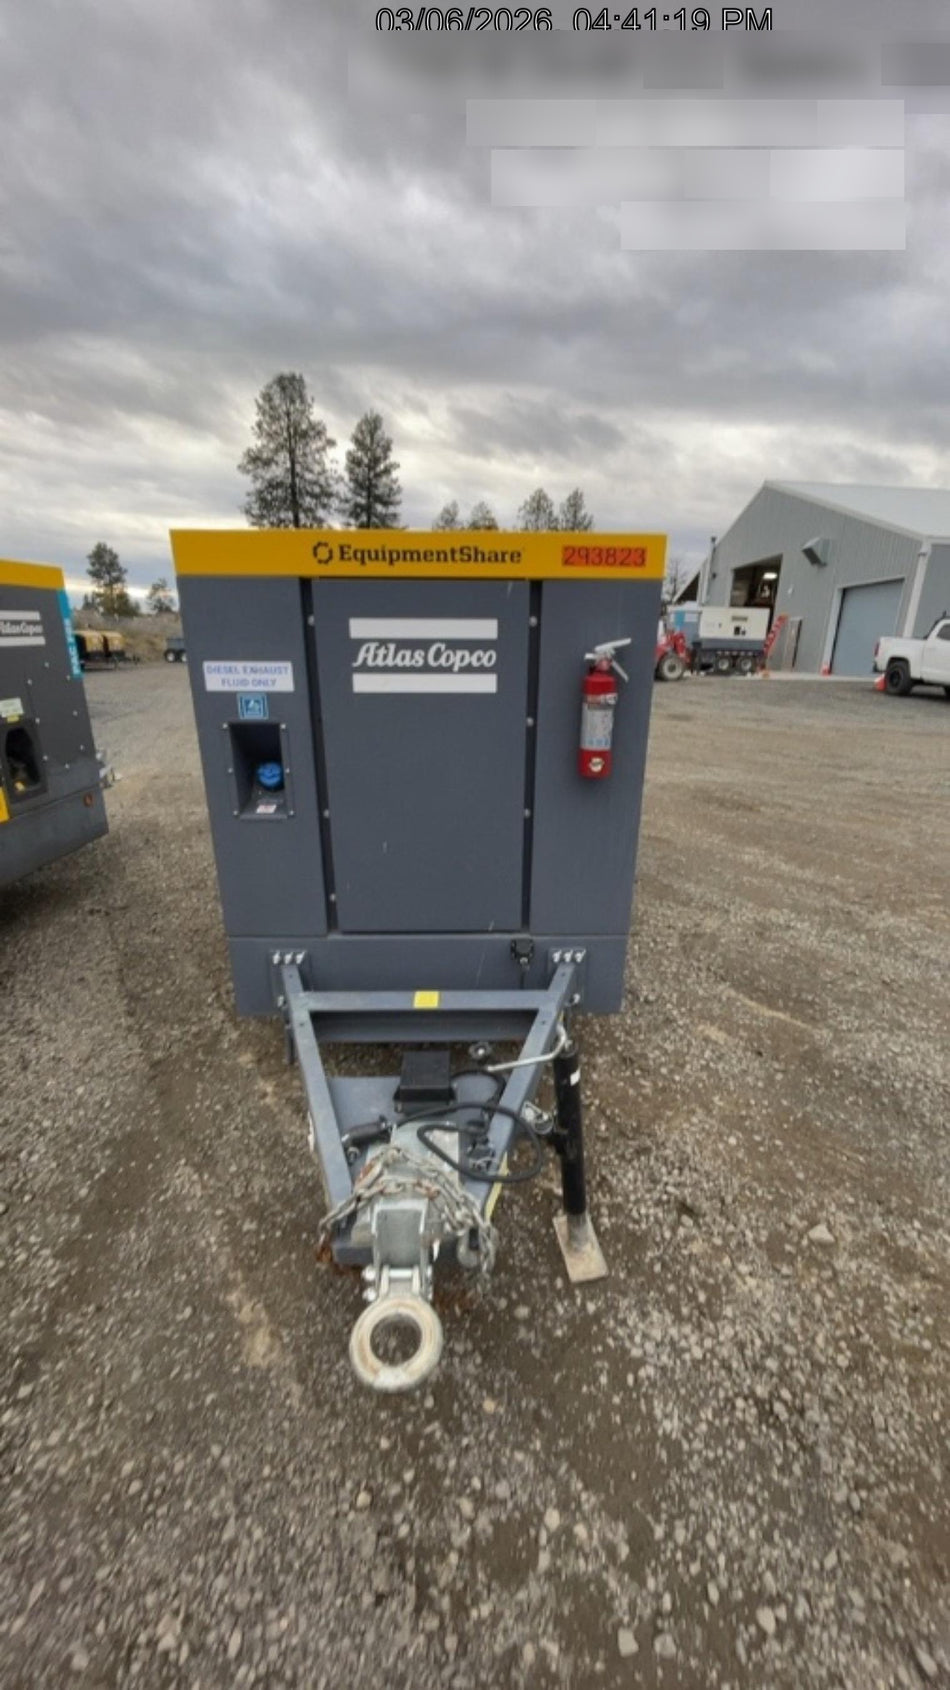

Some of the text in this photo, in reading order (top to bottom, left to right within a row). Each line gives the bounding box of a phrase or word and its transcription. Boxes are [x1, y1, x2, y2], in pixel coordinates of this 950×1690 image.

[338, 544, 522, 566] EquipmentShare
[563, 546, 646, 567] 293823
[352, 641, 497, 672] Atlas Copco
[206, 665, 290, 675] DIESEL EXHAUST
[221, 679, 277, 687] FLUID ONLY
